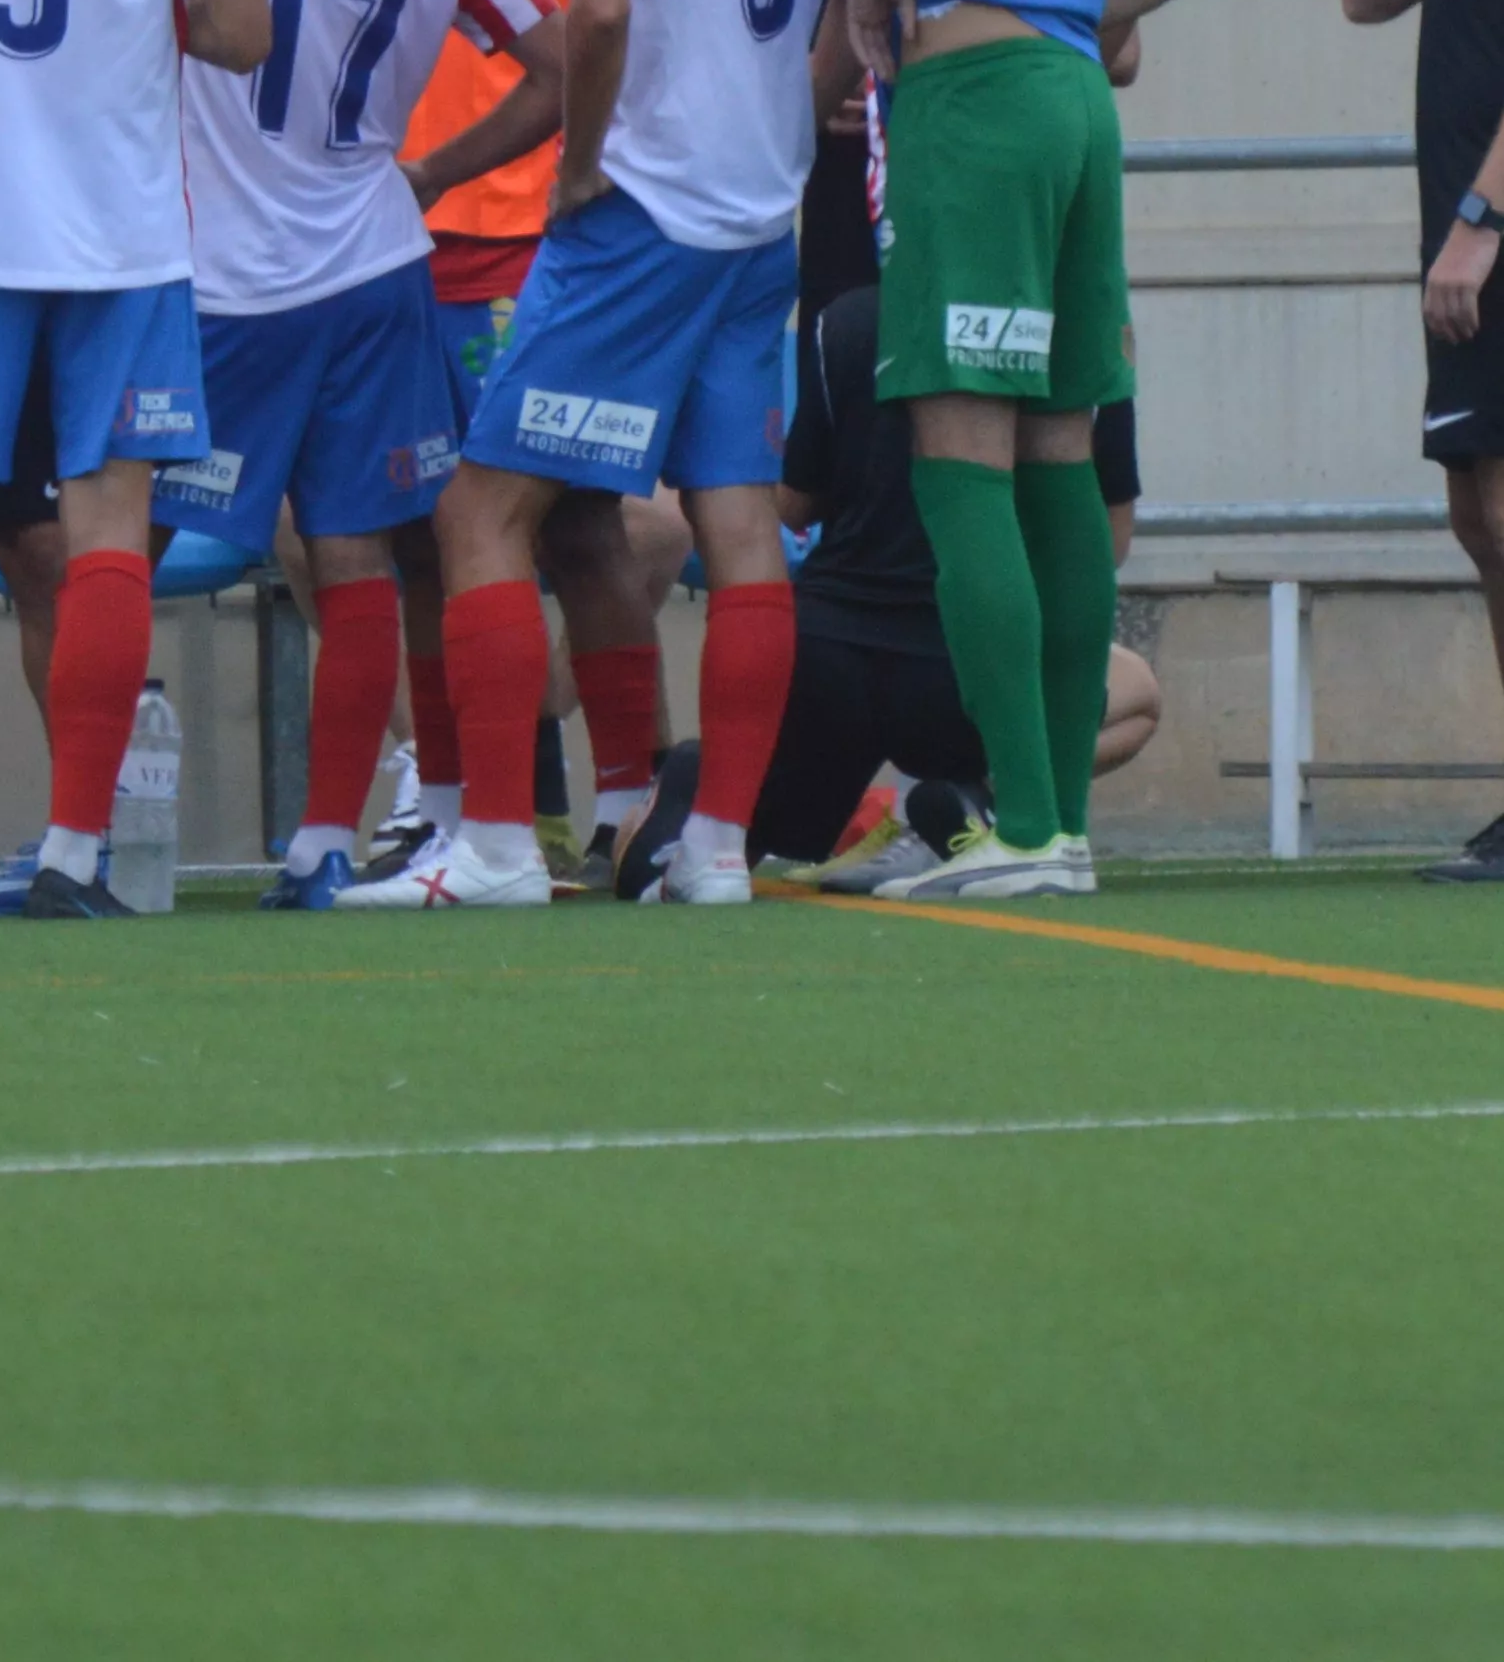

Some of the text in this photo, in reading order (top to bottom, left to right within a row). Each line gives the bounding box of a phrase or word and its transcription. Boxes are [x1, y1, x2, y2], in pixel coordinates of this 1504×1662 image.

[956, 312, 991, 342] 24
[529, 397, 645, 439] 24 siete
[515, 429, 646, 471] PRODUCCIONES
